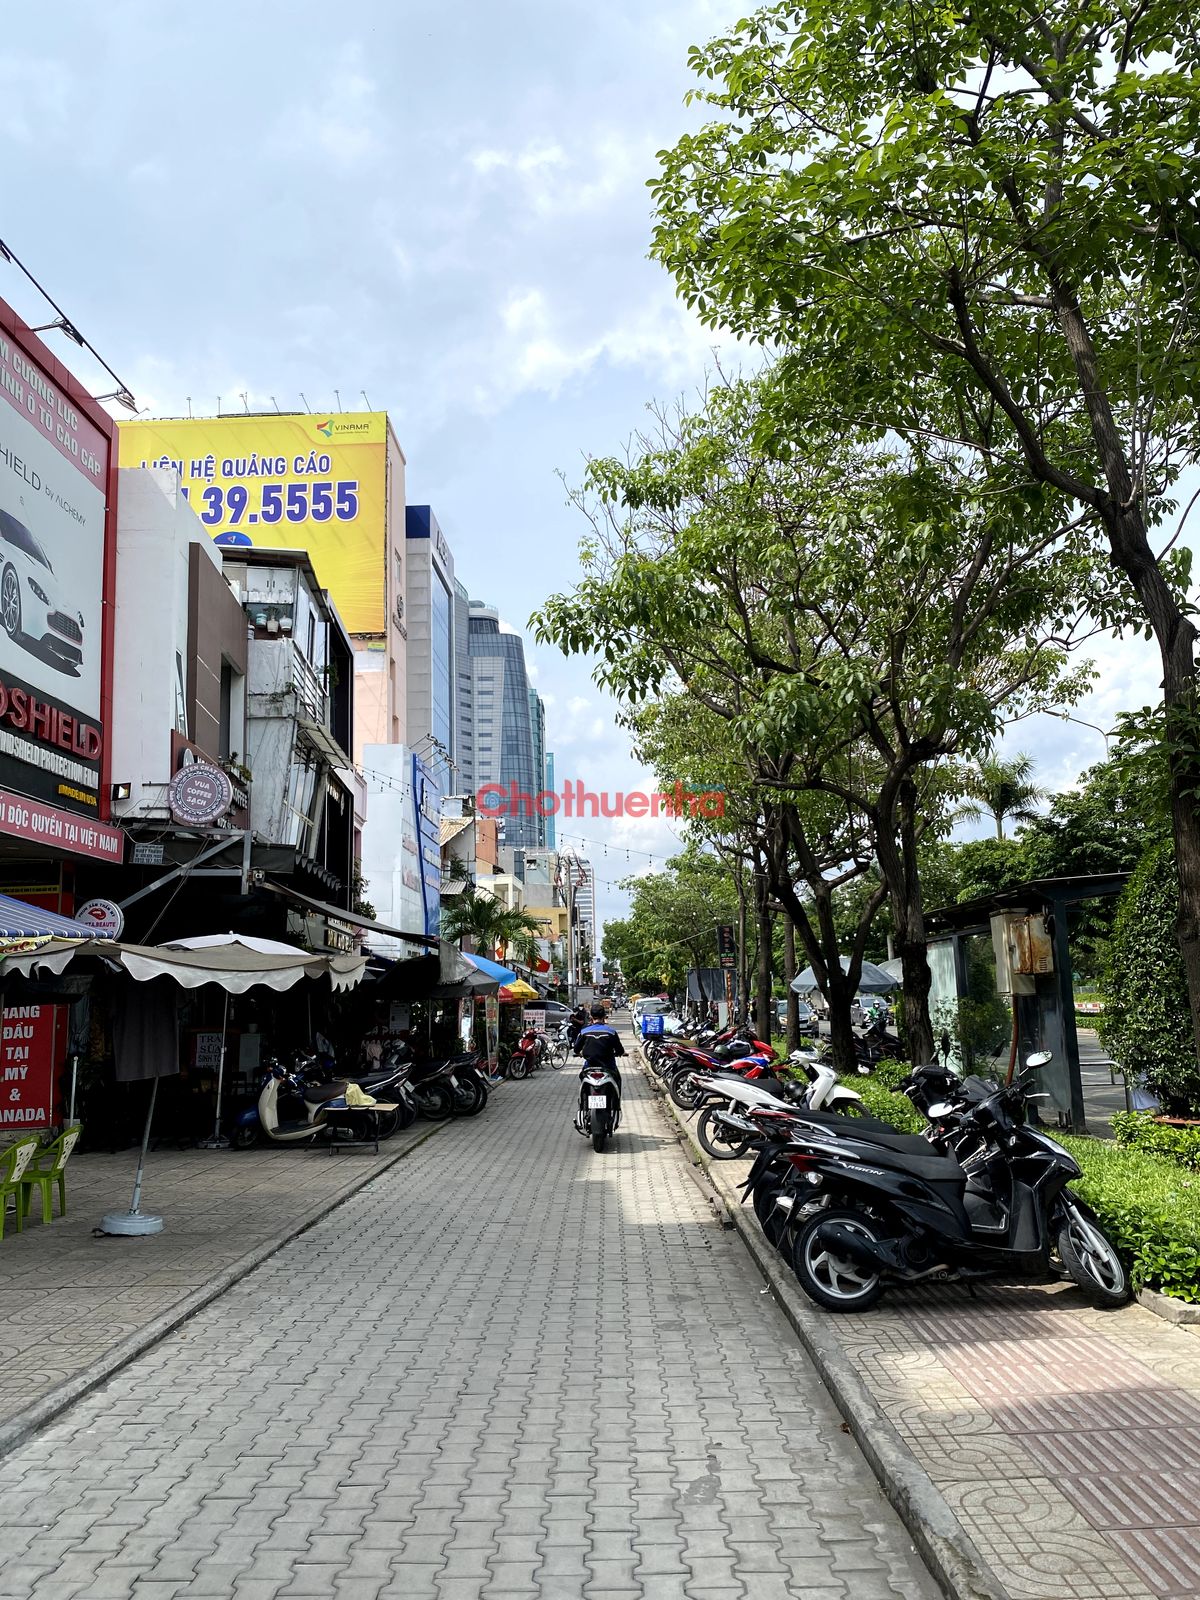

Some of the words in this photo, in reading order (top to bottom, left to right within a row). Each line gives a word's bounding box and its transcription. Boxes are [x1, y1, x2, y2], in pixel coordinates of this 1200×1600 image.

[56, 424, 78, 456] CAO
[190, 454, 215, 483] HỆ
[222, 453, 286, 479] QUẢNG
[293, 450, 331, 475] CÁO
[187, 788, 213, 799] COFFEE
[194, 781, 210, 790] VUA
[8, 805, 28, 829] ĐỘC
[32, 813, 62, 838] QUYỀN
[65, 823, 78, 844] TẠI
[80, 827, 97, 849] VIỆT
[99, 835, 118, 853] NAM
[3, 1022, 34, 1039] ĐẦU
[6, 1046, 29, 1062] TẠI
[4, 1064, 29, 1081] MỸ
[9, 1088, 21, 1101] &
[838, 1160, 885, 1176] VISION
